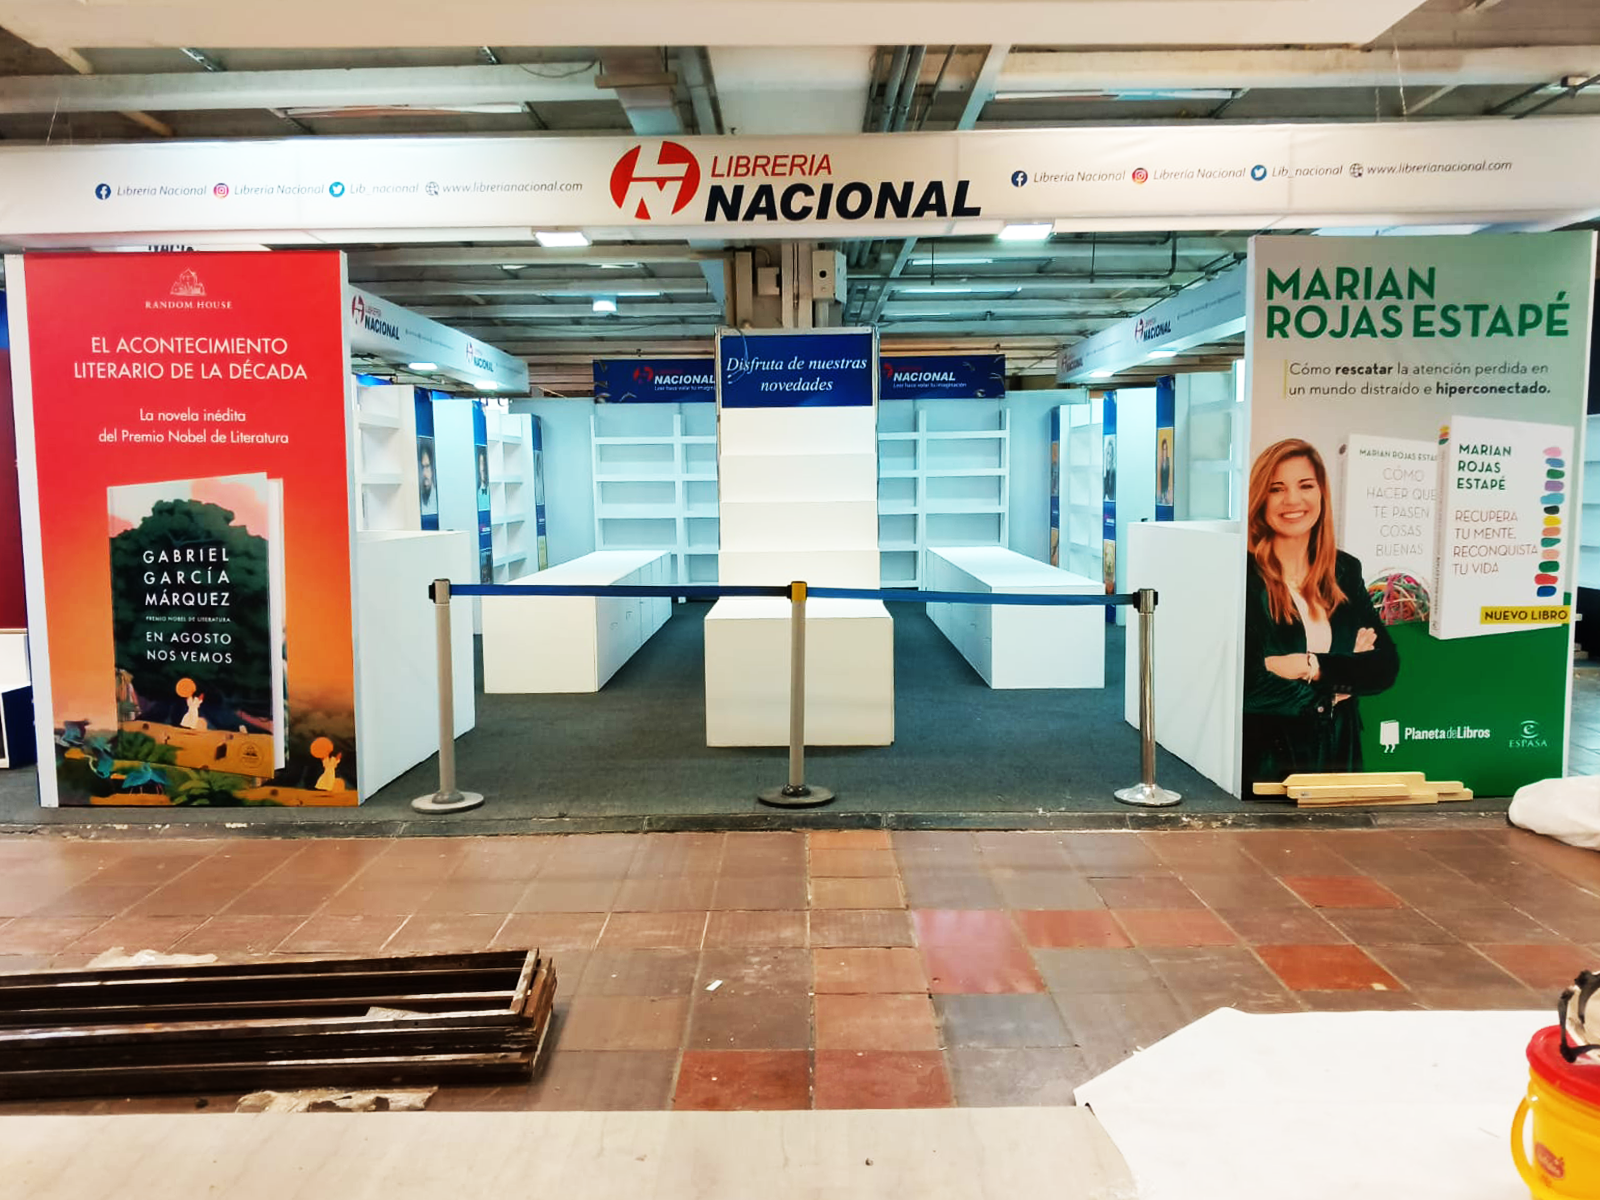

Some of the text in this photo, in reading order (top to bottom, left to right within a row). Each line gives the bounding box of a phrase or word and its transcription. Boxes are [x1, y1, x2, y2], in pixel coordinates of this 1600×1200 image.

[711, 154, 832, 178] LIBRERIA
[1197, 167, 1246, 179] Nacional
[1272, 165, 1343, 178] Lib_nacional
[1367, 160, 1513, 175] www.librerianacional.com
[1077, 170, 1126, 182] Nacional
[159, 184, 207, 196] Nacional
[277, 184, 325, 195] Nacional
[350, 182, 419, 196] Lib_nacional
[443, 181, 583, 193] www.librerianacional.com
[704, 180, 981, 222] NACIONAL
[1266, 267, 1436, 300] MARIAN
[145, 301, 232, 309] RANDOM HOUSE
[1266, 304, 1403, 339] ROJAS
[1412, 291, 1570, 338] ESTAPÉ
[365, 314, 400, 340] NACIONAL
[91, 336, 288, 355] EL ACONTECIMIENTO
[74, 359, 308, 380] LITERARIO DE LA DÉCADA
[726, 356, 868, 375] Disfruta de nuestras
[1289, 361, 1549, 377] Cómo rescatar la atención perdida en
[654, 374, 716, 385] NACIONAL
[893, 372, 956, 382] NACIONAL
[760, 378, 833, 392] novedades
[1289, 381, 1551, 397] un mundo distraído e hiperconectado.
[140, 407, 246, 422] La novela inédita
[98, 428, 289, 444] del Premio Nobel de Literatura
[1359, 449, 1437, 461] MARIAN ROJAS ESTA
[1459, 444, 1512, 456] MARIAN
[1457, 460, 1501, 474] ROJAS
[1457, 476, 1506, 491] ESTAPÉ
[1366, 486, 1437, 501] HACER QUE
[1373, 506, 1430, 519] TE PASEN
[1455, 510, 1519, 523] RECUPERA
[1380, 524, 1422, 537] COSAS
[1454, 528, 1470, 540] TU
[142, 547, 229, 564] GABRIEL
[1376, 543, 1423, 557] BUENAS
[1453, 544, 1538, 558] RECONQUISTA
[143, 566, 230, 585] GARCÍA
[1452, 562, 1499, 576] TU VIDA
[145, 588, 230, 606] MÁRQUEZ
[1484, 609, 1568, 621] NUEVO LIBRO
[146, 632, 232, 645] EN AGOSTO
[147, 650, 232, 664] NOS VEMOS
[1509, 739, 1548, 748] ESPASA
